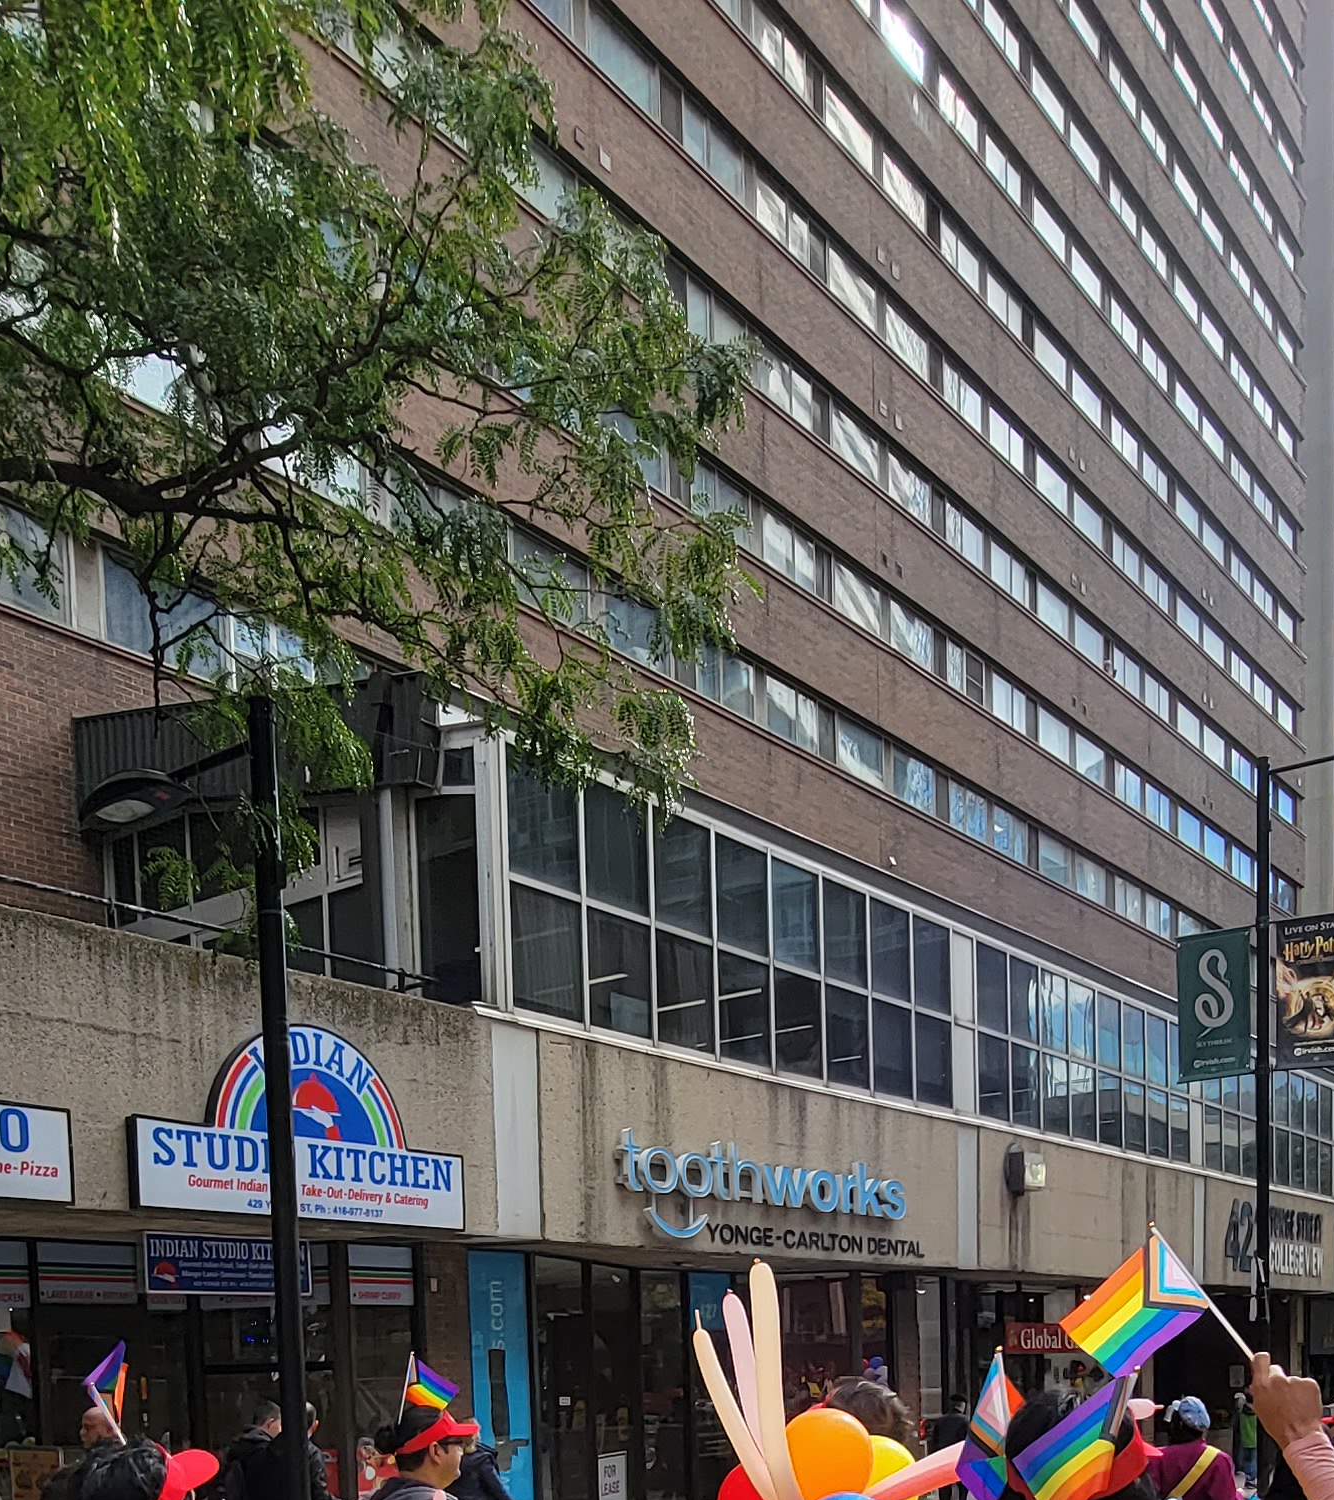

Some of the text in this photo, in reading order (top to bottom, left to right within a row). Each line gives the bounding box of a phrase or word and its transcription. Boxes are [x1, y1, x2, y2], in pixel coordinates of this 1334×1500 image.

[1284, 926, 1303, 936] LIVE
[1304, 923, 1319, 933] ON
[1282, 940, 1315, 962] Harry
[247, 1030, 374, 1096] IDIAN
[152, 1127, 453, 1192] STUDI KITCHEN
[616, 1127, 907, 1221] toothworks
[187, 1173, 429, 1209] Gourmet Indian Take-Out-Delivery & Catering
[247, 1199, 263, 1209] 429
[150, 1239, 305, 1262] INDIAN STUDIO KITN
[706, 1223, 925, 1258] YONGE-CARLTON DENTAL
[1020, 1328, 1062, 1350] Global
[603, 1464, 617, 1478] FOR
[601, 1480, 620, 1496] LEASE
